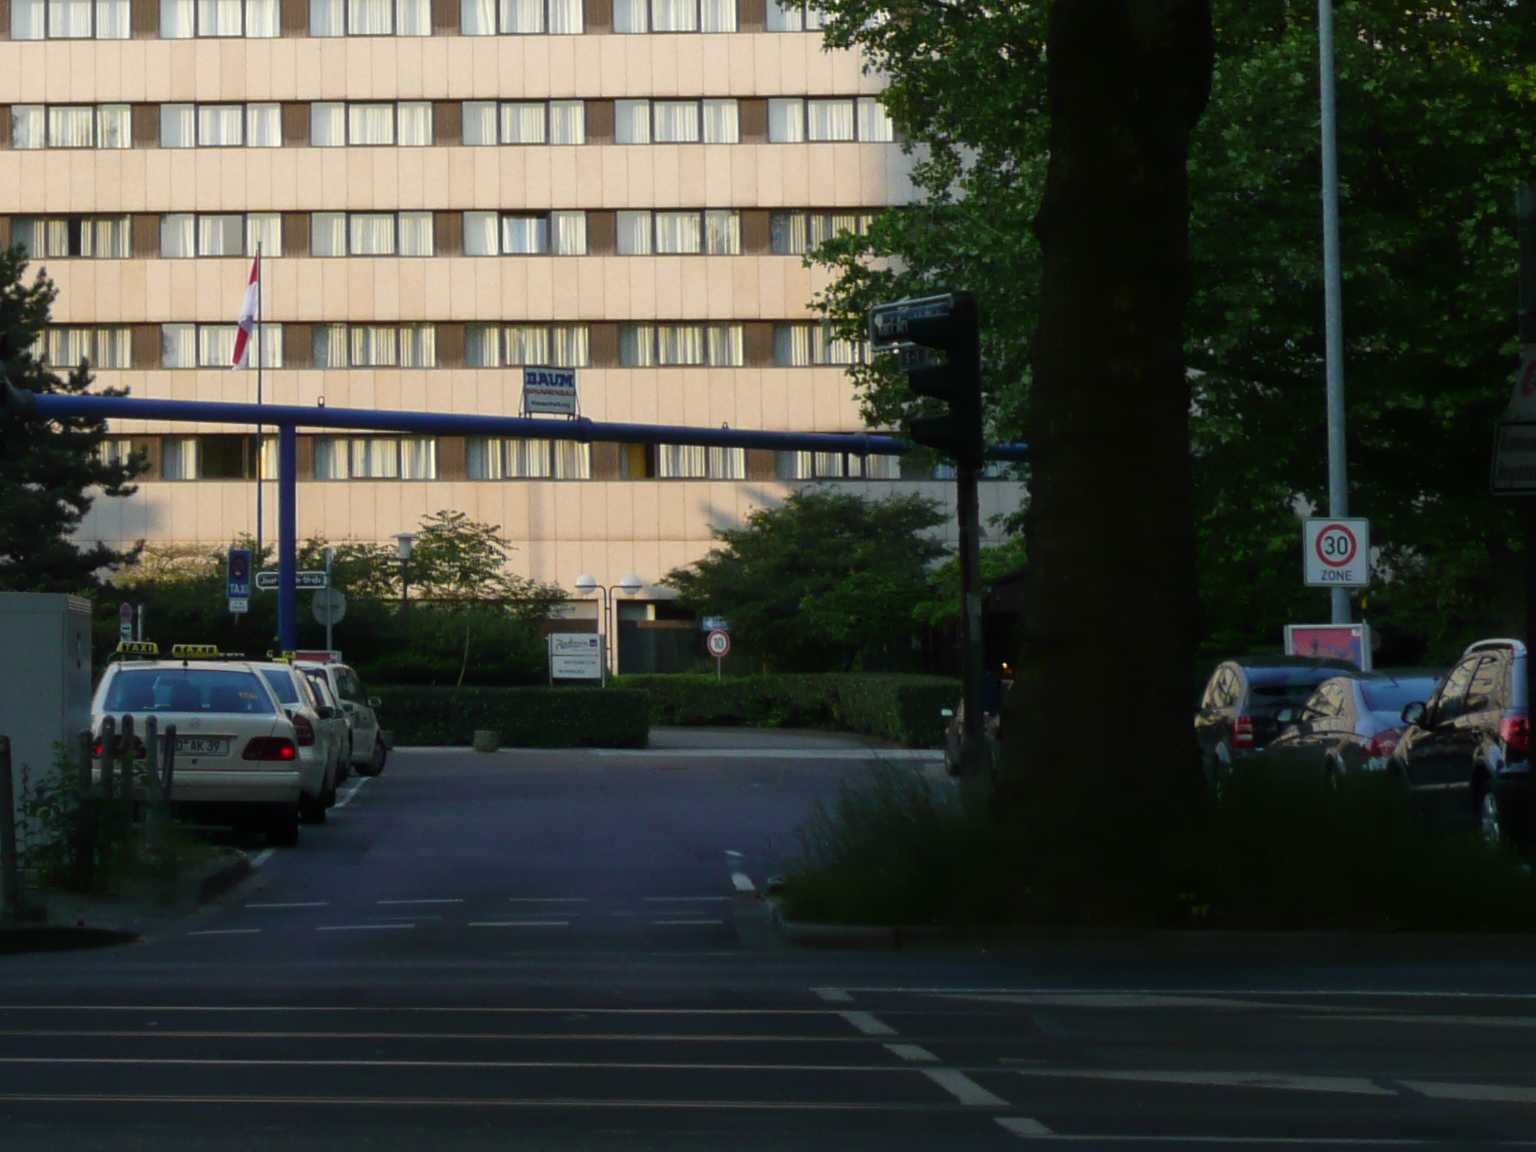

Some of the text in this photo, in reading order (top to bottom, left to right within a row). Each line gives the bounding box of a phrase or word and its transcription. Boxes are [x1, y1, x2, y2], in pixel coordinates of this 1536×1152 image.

[526, 372, 573, 387] BAUM
[1324, 536, 1348, 555] 30
[1321, 570, 1353, 581] ZONE
[229, 583, 250, 594] TAXI
[124, 643, 153, 653] TAXI
[713, 637, 724, 649] 10
[191, 740, 205, 751] AK
[207, 740, 220, 751] 39
